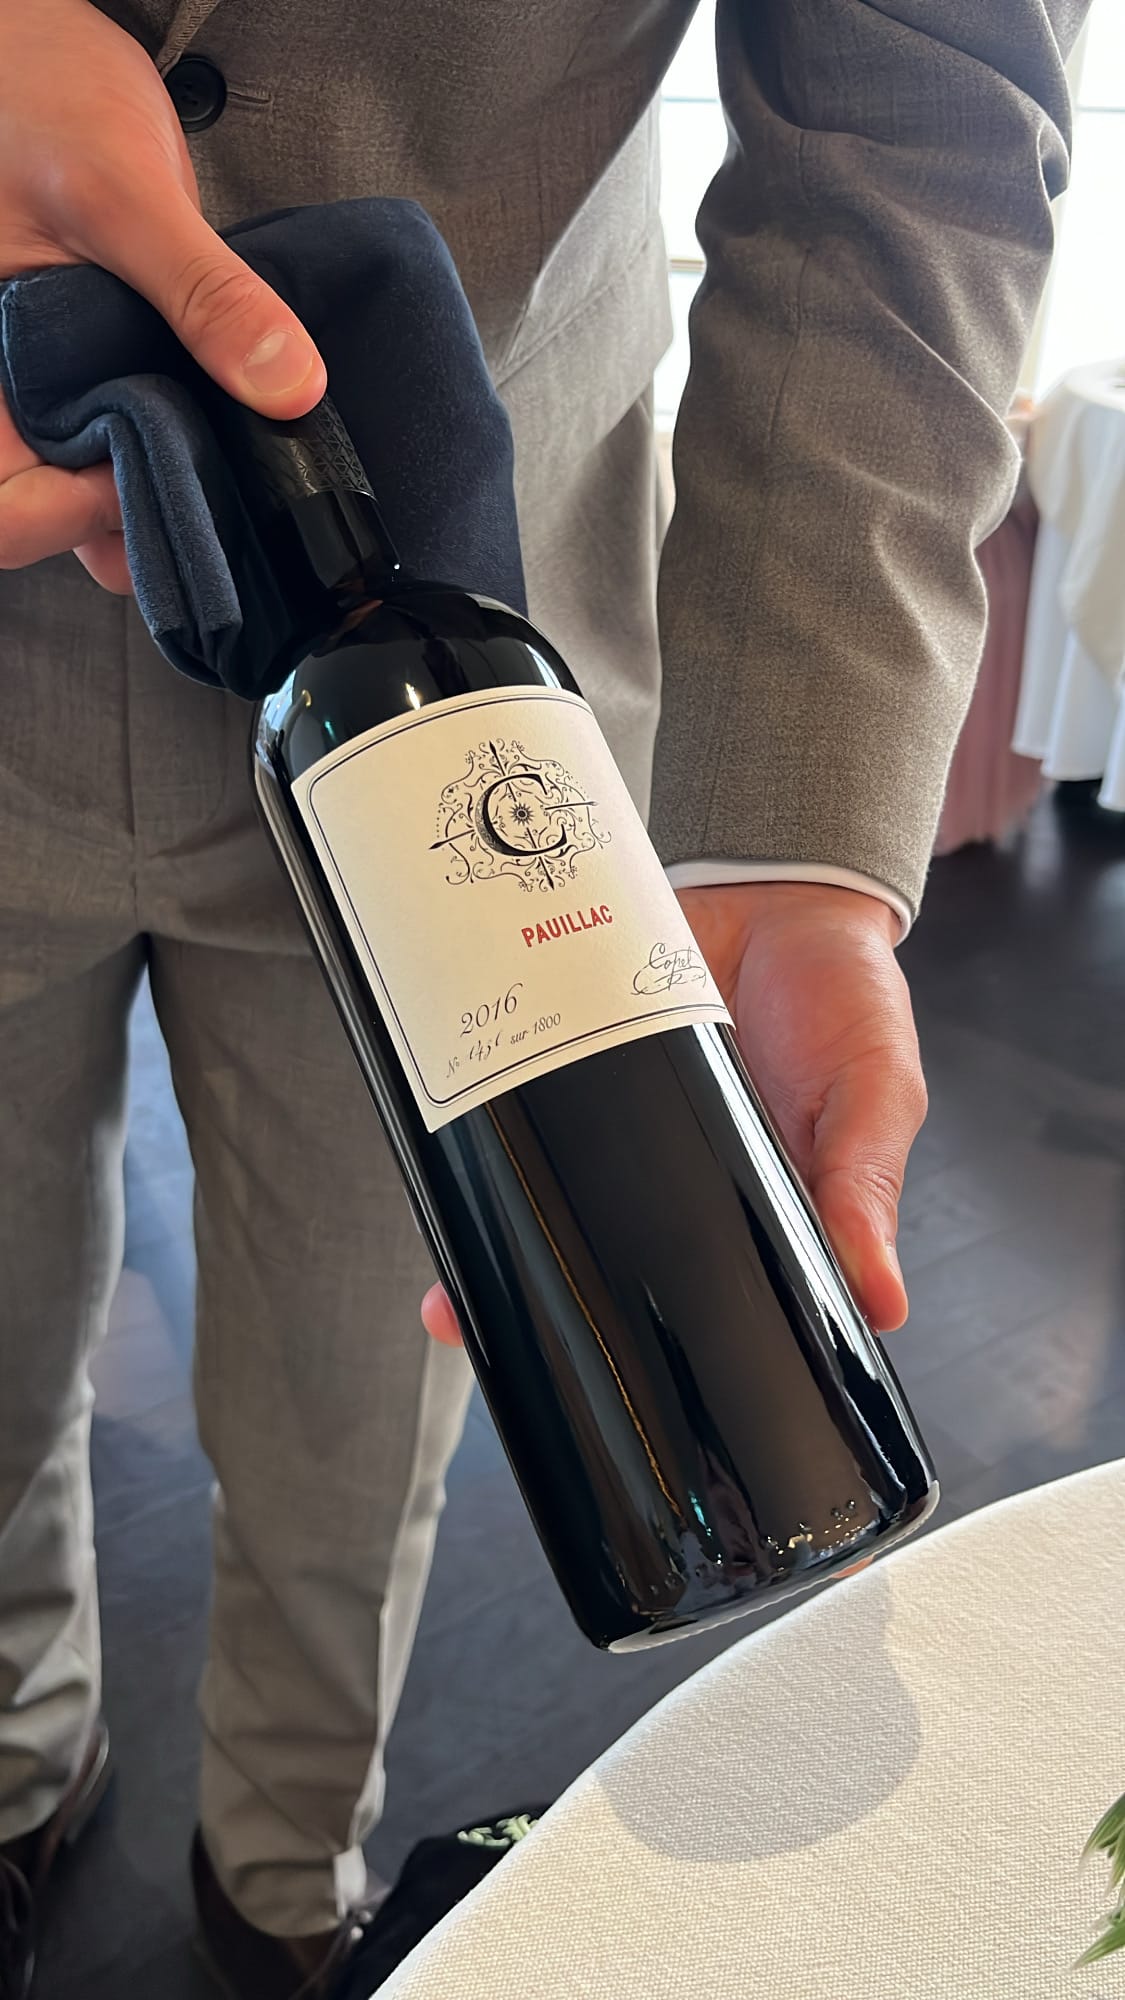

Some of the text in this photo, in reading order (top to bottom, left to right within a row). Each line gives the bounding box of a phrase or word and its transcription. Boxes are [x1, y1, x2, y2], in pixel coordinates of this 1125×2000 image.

[475, 773, 568, 857] C
[521, 904, 613, 948] PAUILLAC
[460, 982, 524, 1038] 2016
[510, 1030, 529, 1045] sur
[534, 1012, 561, 1036] 1800
